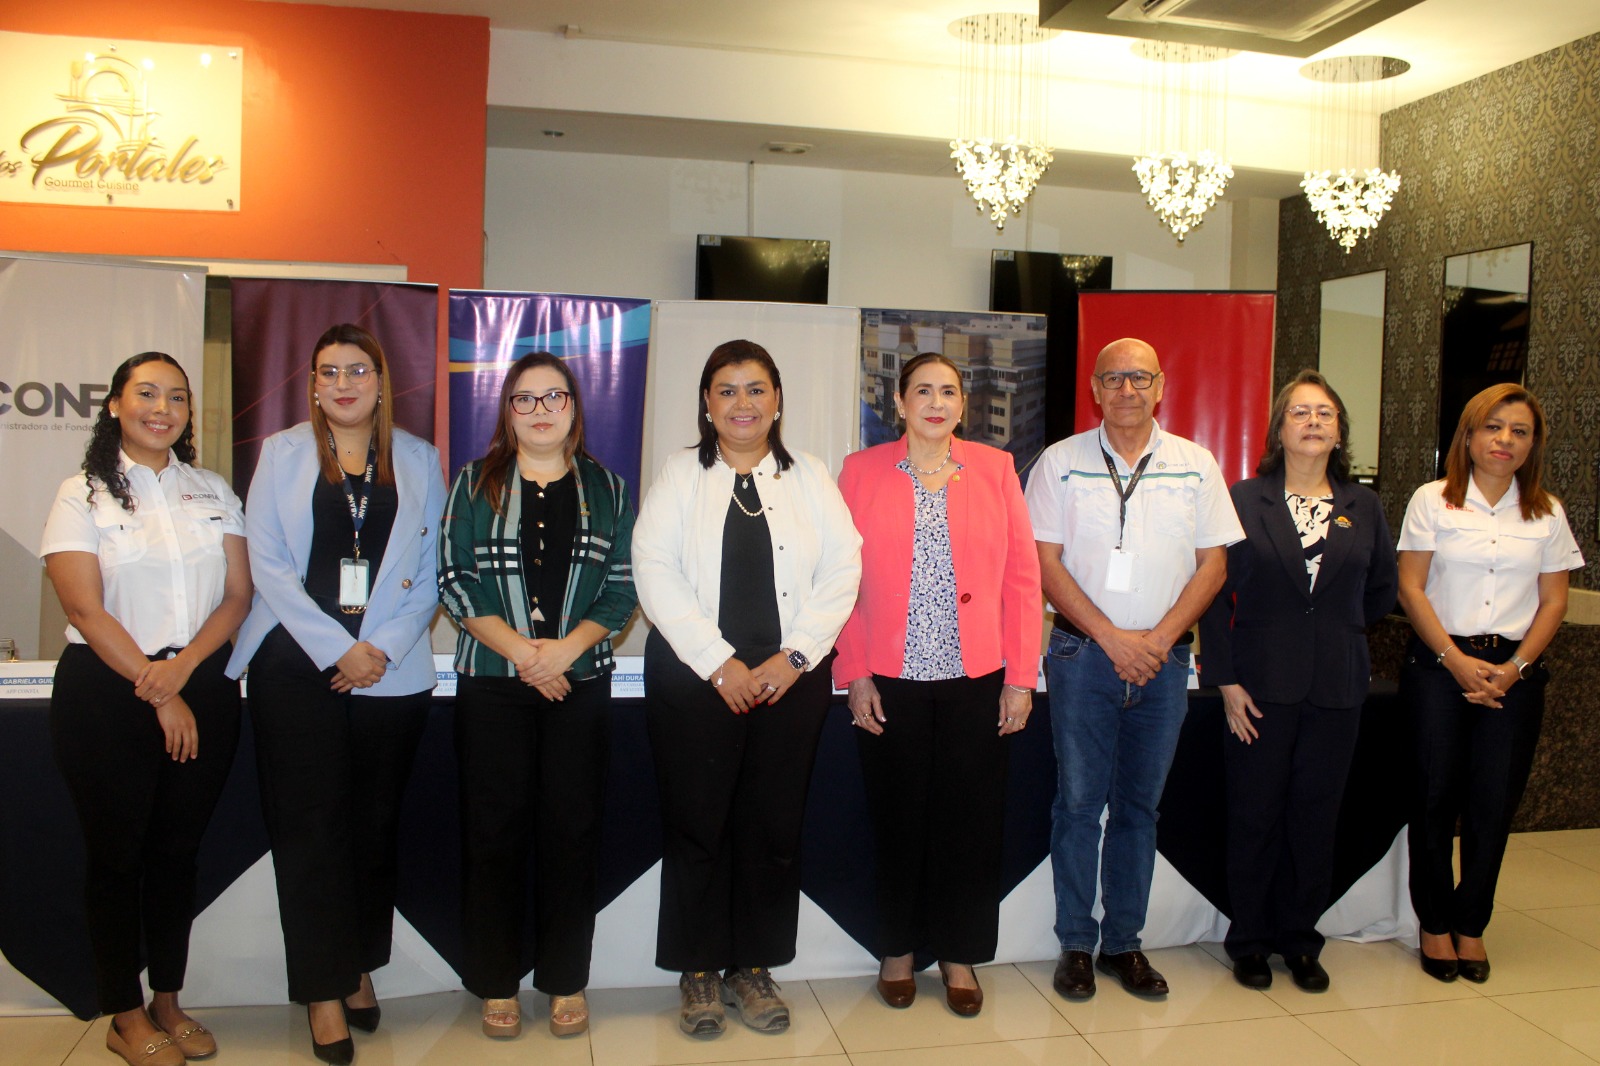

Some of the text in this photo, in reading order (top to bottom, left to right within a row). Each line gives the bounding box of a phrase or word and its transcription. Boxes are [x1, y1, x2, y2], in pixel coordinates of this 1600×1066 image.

[20, 115, 226, 188] Portales
[44, 176, 93, 188] Gourmet
[51, 423, 62, 431] de
[364, 463, 374, 483] ABANK
[346, 493, 358, 518] ABANK
[357, 495, 369, 520] ABANK
